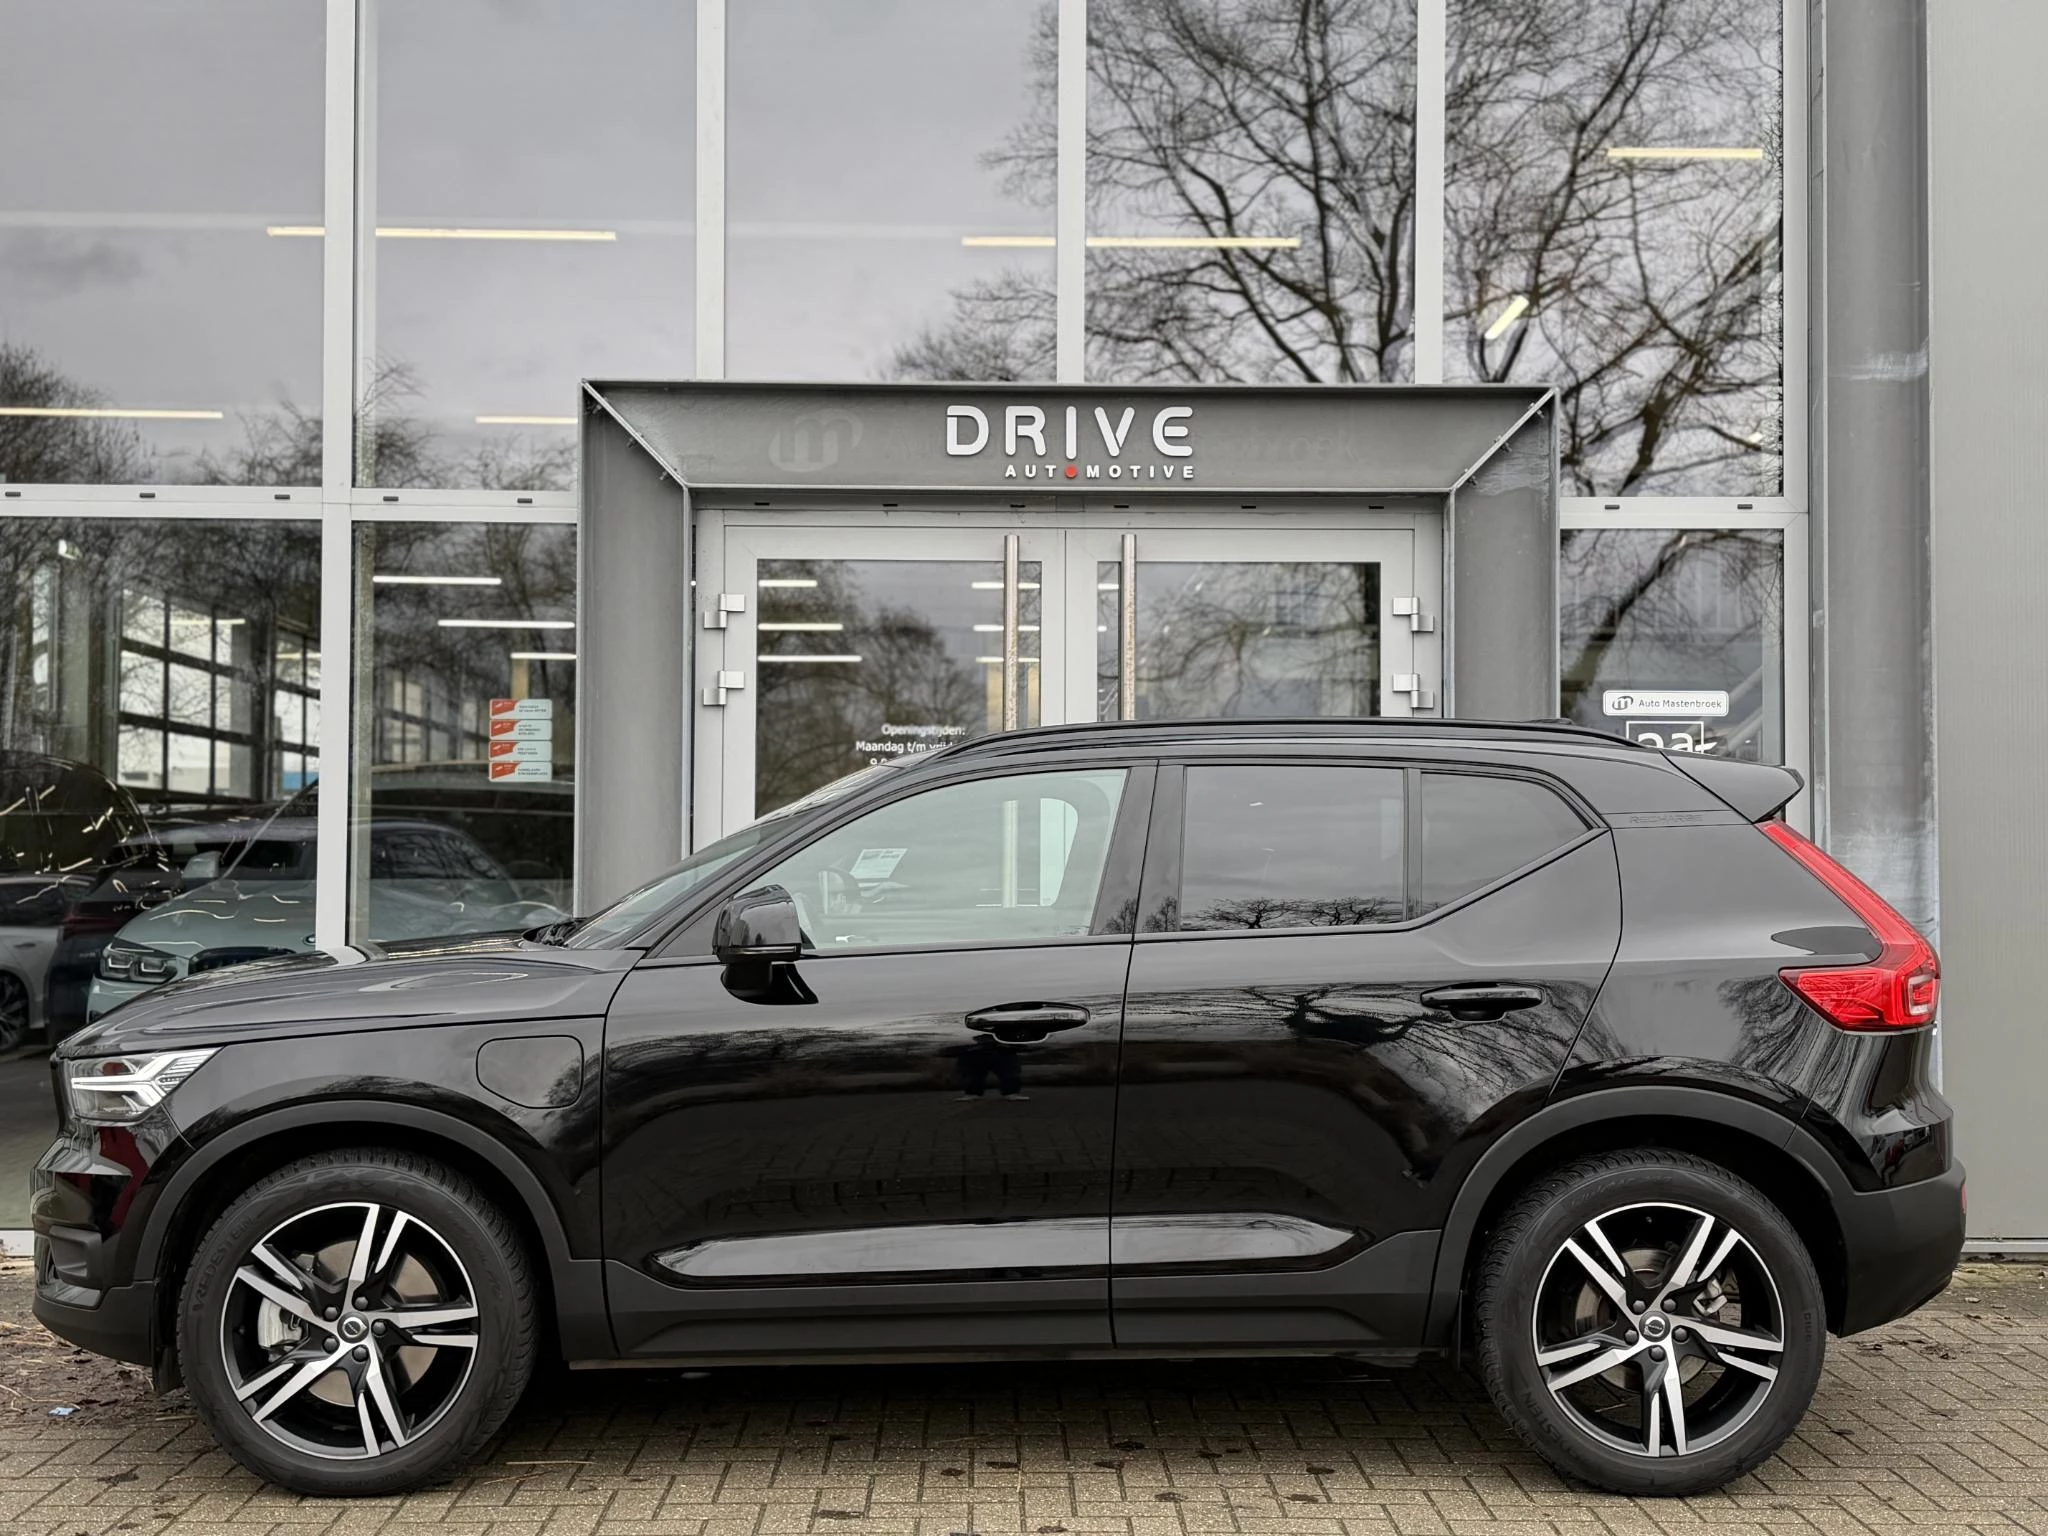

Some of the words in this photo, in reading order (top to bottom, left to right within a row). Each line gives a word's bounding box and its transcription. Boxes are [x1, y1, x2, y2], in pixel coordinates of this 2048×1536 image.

[946, 405, 1194, 460] DRIVE
[1638, 699, 1661, 708] Auto
[1663, 699, 1722, 708] Mastenbroek
[855, 741, 904, 754] Maandag
[907, 741, 926, 752] t/m
